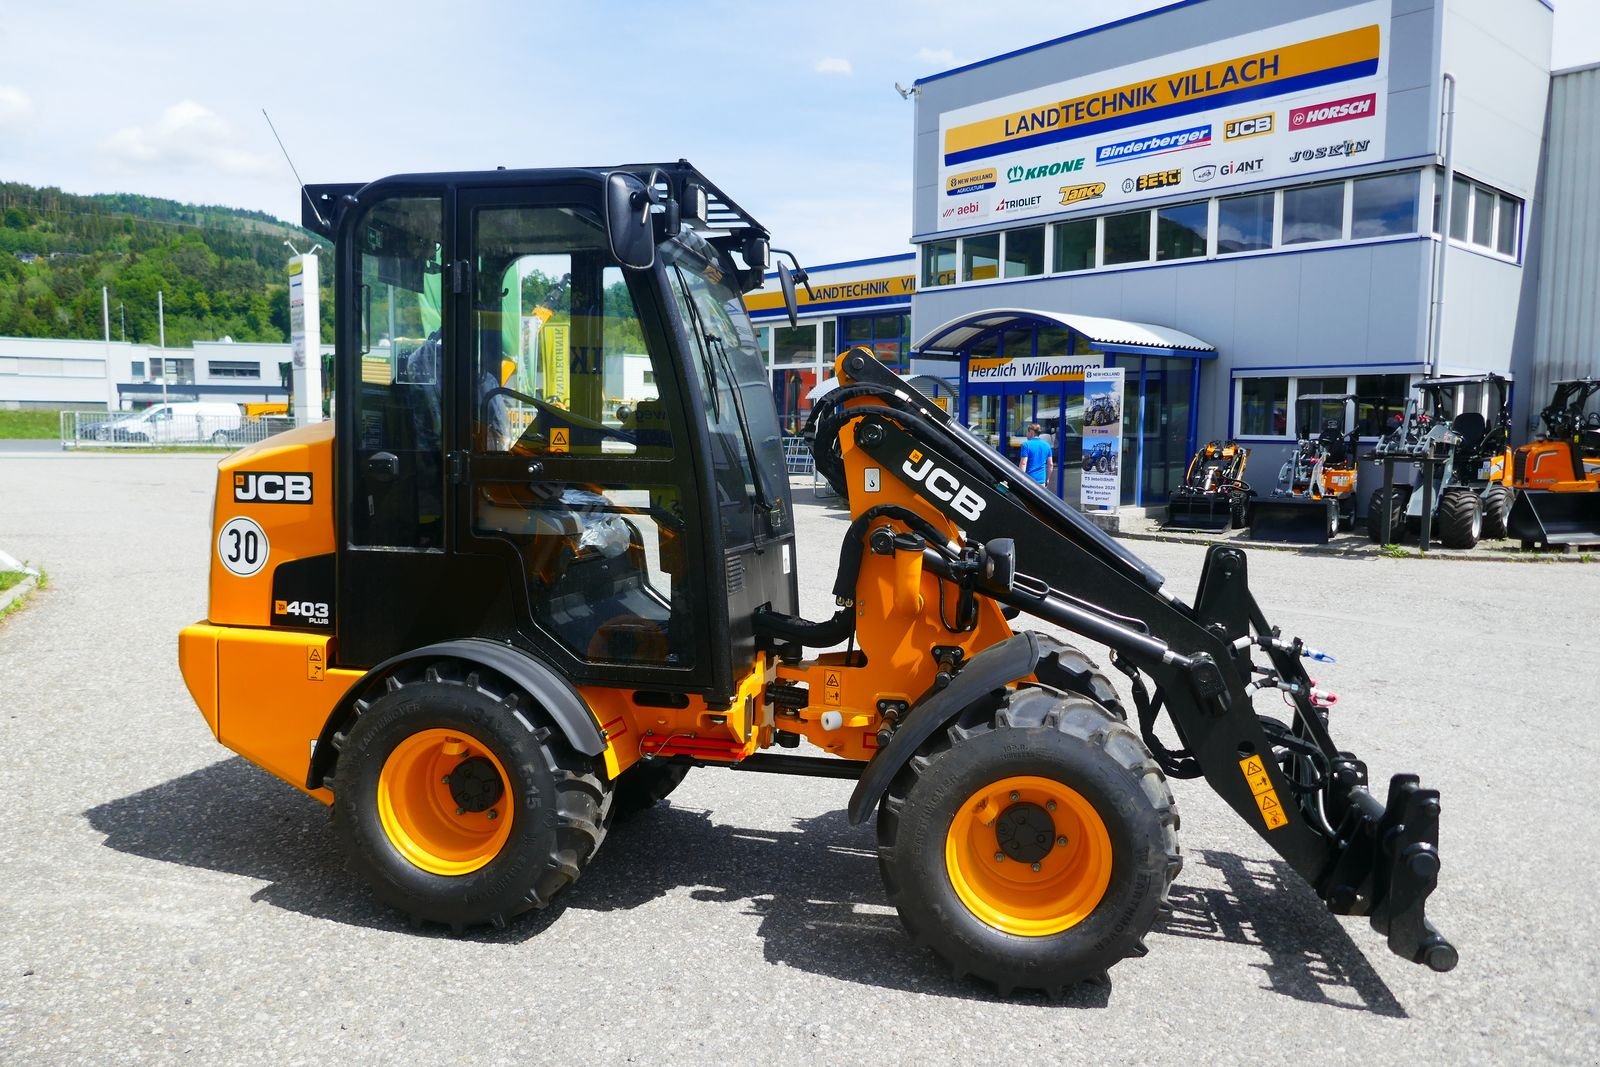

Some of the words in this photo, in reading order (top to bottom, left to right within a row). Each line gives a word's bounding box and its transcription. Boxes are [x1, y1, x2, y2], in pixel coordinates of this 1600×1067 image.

[1005, 84, 1157, 137] LANDTECHNIK
[1168, 55, 1279, 98] VILLACH
[1306, 99, 1371, 123] HORSCH
[1226, 116, 1273, 138] JCB
[1099, 129, 1209, 159] Binderberger
[1289, 140, 1371, 163] JOSKIN
[969, 173, 993, 183] HOLLAND
[1025, 158, 1085, 181] KRONE
[957, 184, 985, 194] AGRICULTURE
[1059, 182, 1106, 205] Tanco
[957, 202, 979, 215] aebi
[971, 362, 1017, 378] Herzlich
[235, 474, 312, 501] JCB
[902, 458, 987, 522] JCB
[228, 528, 258, 565] 30
[287, 601, 329, 618] 403
[308, 617, 329, 625] PLUS
